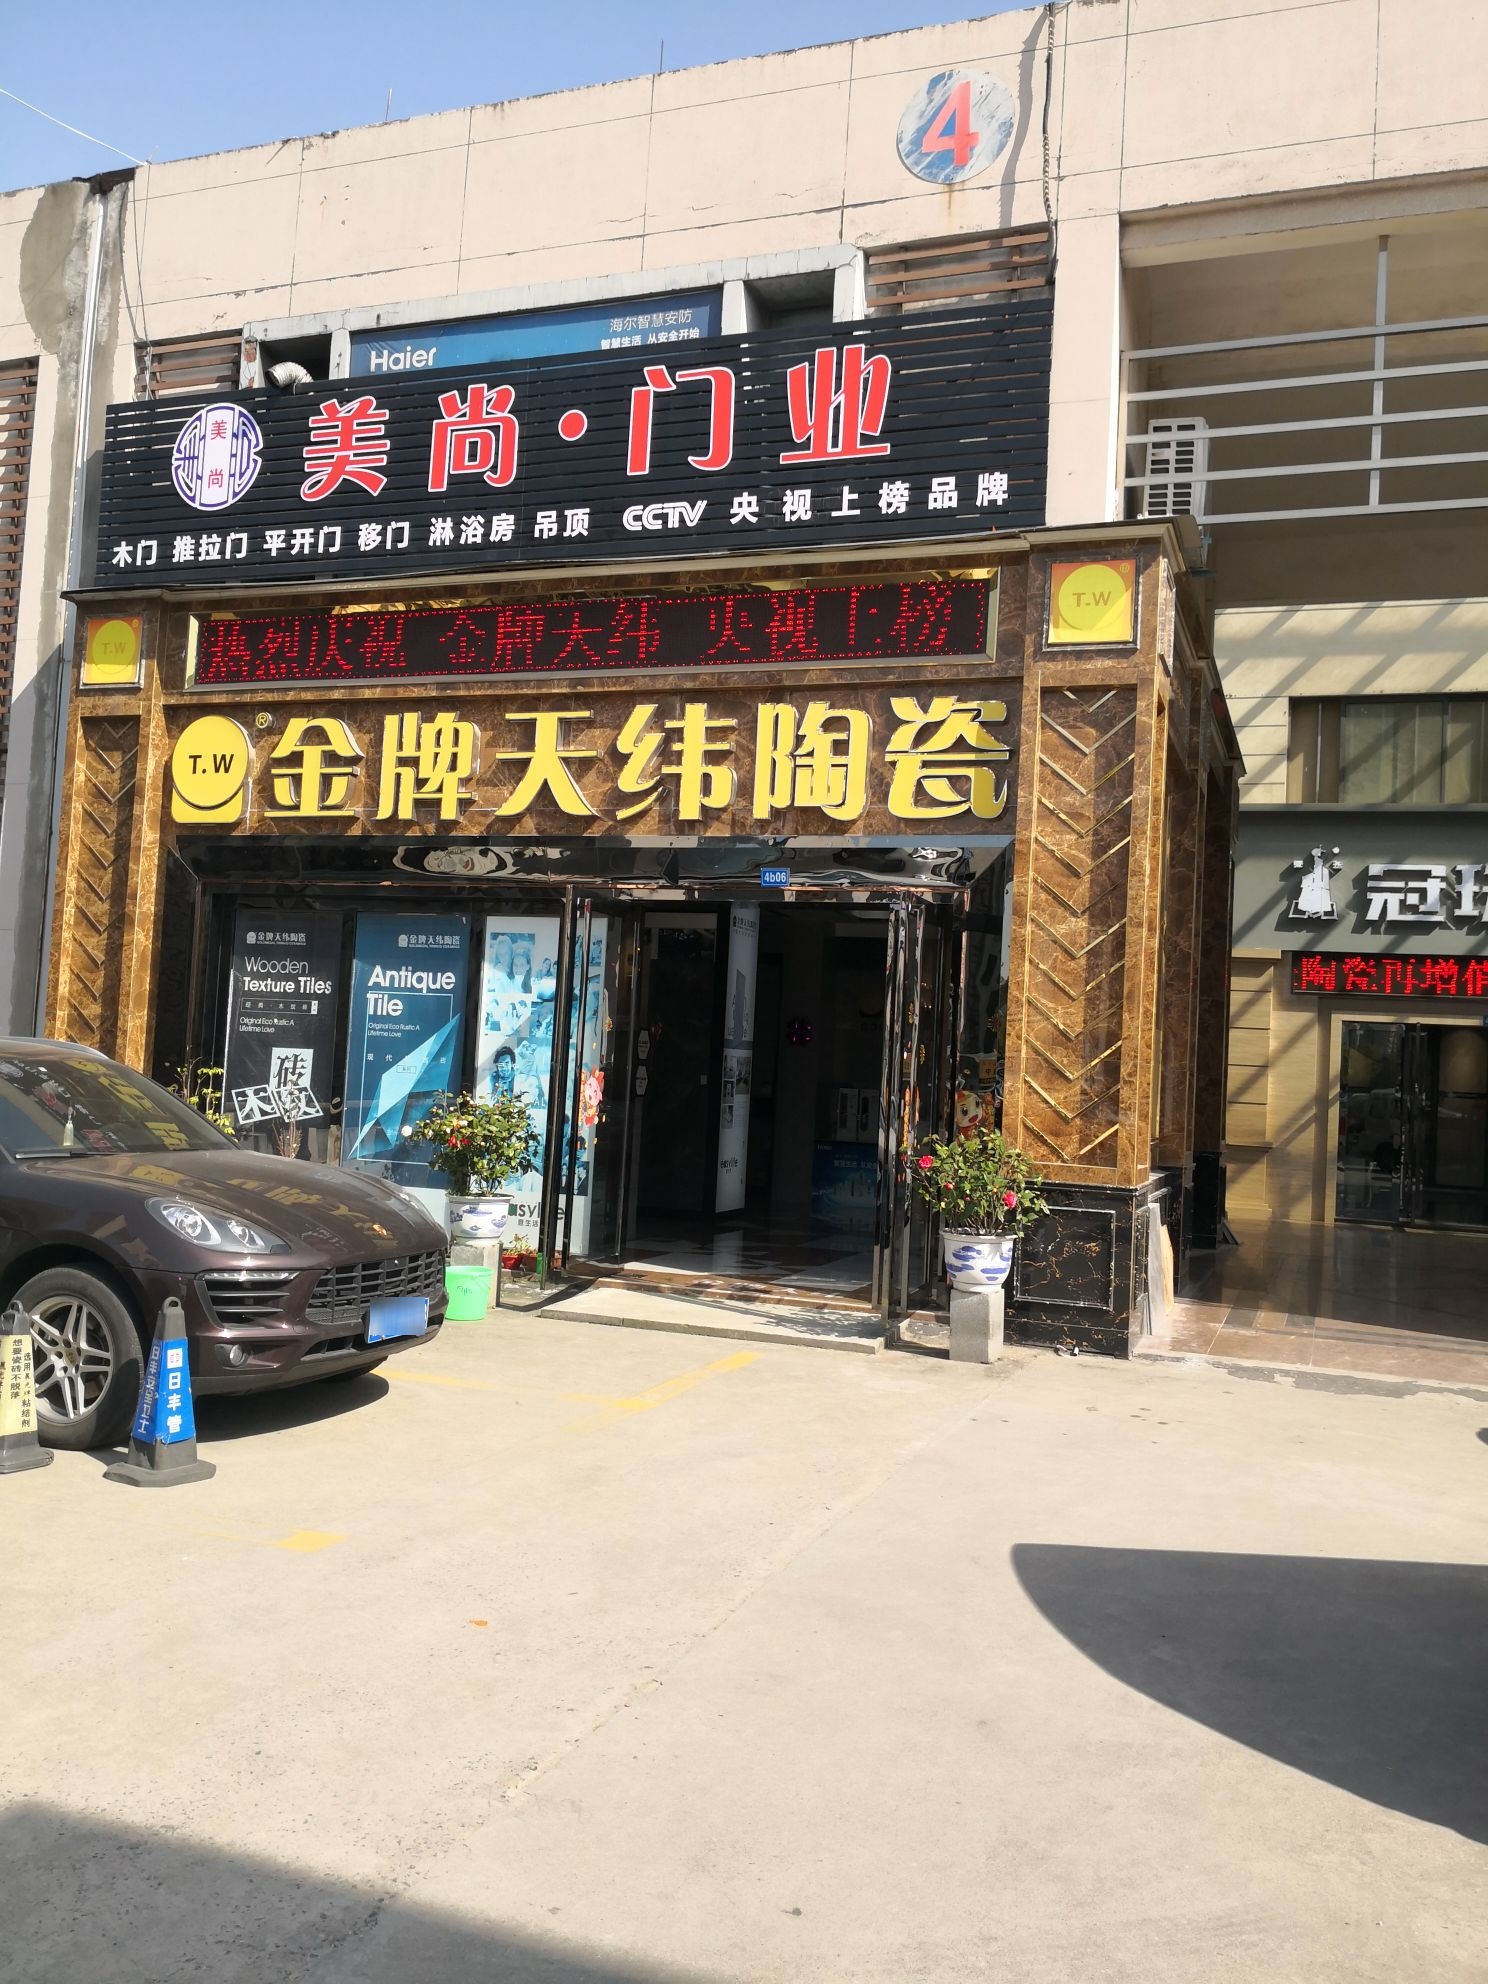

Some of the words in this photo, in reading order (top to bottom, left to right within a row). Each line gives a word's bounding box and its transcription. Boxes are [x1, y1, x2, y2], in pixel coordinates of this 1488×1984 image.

[921, 80, 981, 167] 4
[609, 309, 693, 333] 海尔智慧安防
[647, 327, 700, 345] 从安全开始
[370, 345, 437, 373] Haier
[728, 471, 1010, 526] 央视上榜品牌
[622, 499, 708, 532] CCTV
[112, 540, 157, 568] 木门
[172, 532, 248, 562] 推拉门
[263, 525, 342, 556] 平开门
[358, 521, 411, 552] 移门
[429, 513, 515, 547] 淋浴房
[533, 507, 591, 540] 吊顶
[1072, 591, 1112, 608] T.W
[189, 753, 235, 775] T.W
[263, 696, 1013, 821] 金牌天纬陶瓷
[764, 872, 787, 883] 4b06
[244, 955, 309, 975] Wooden
[242, 976, 296, 993] Texture
[297, 976, 333, 995] Tiles
[367, 964, 456, 994] Antique
[366, 993, 404, 1017] Tile
[166, 1371, 182, 1435] 日丰管
